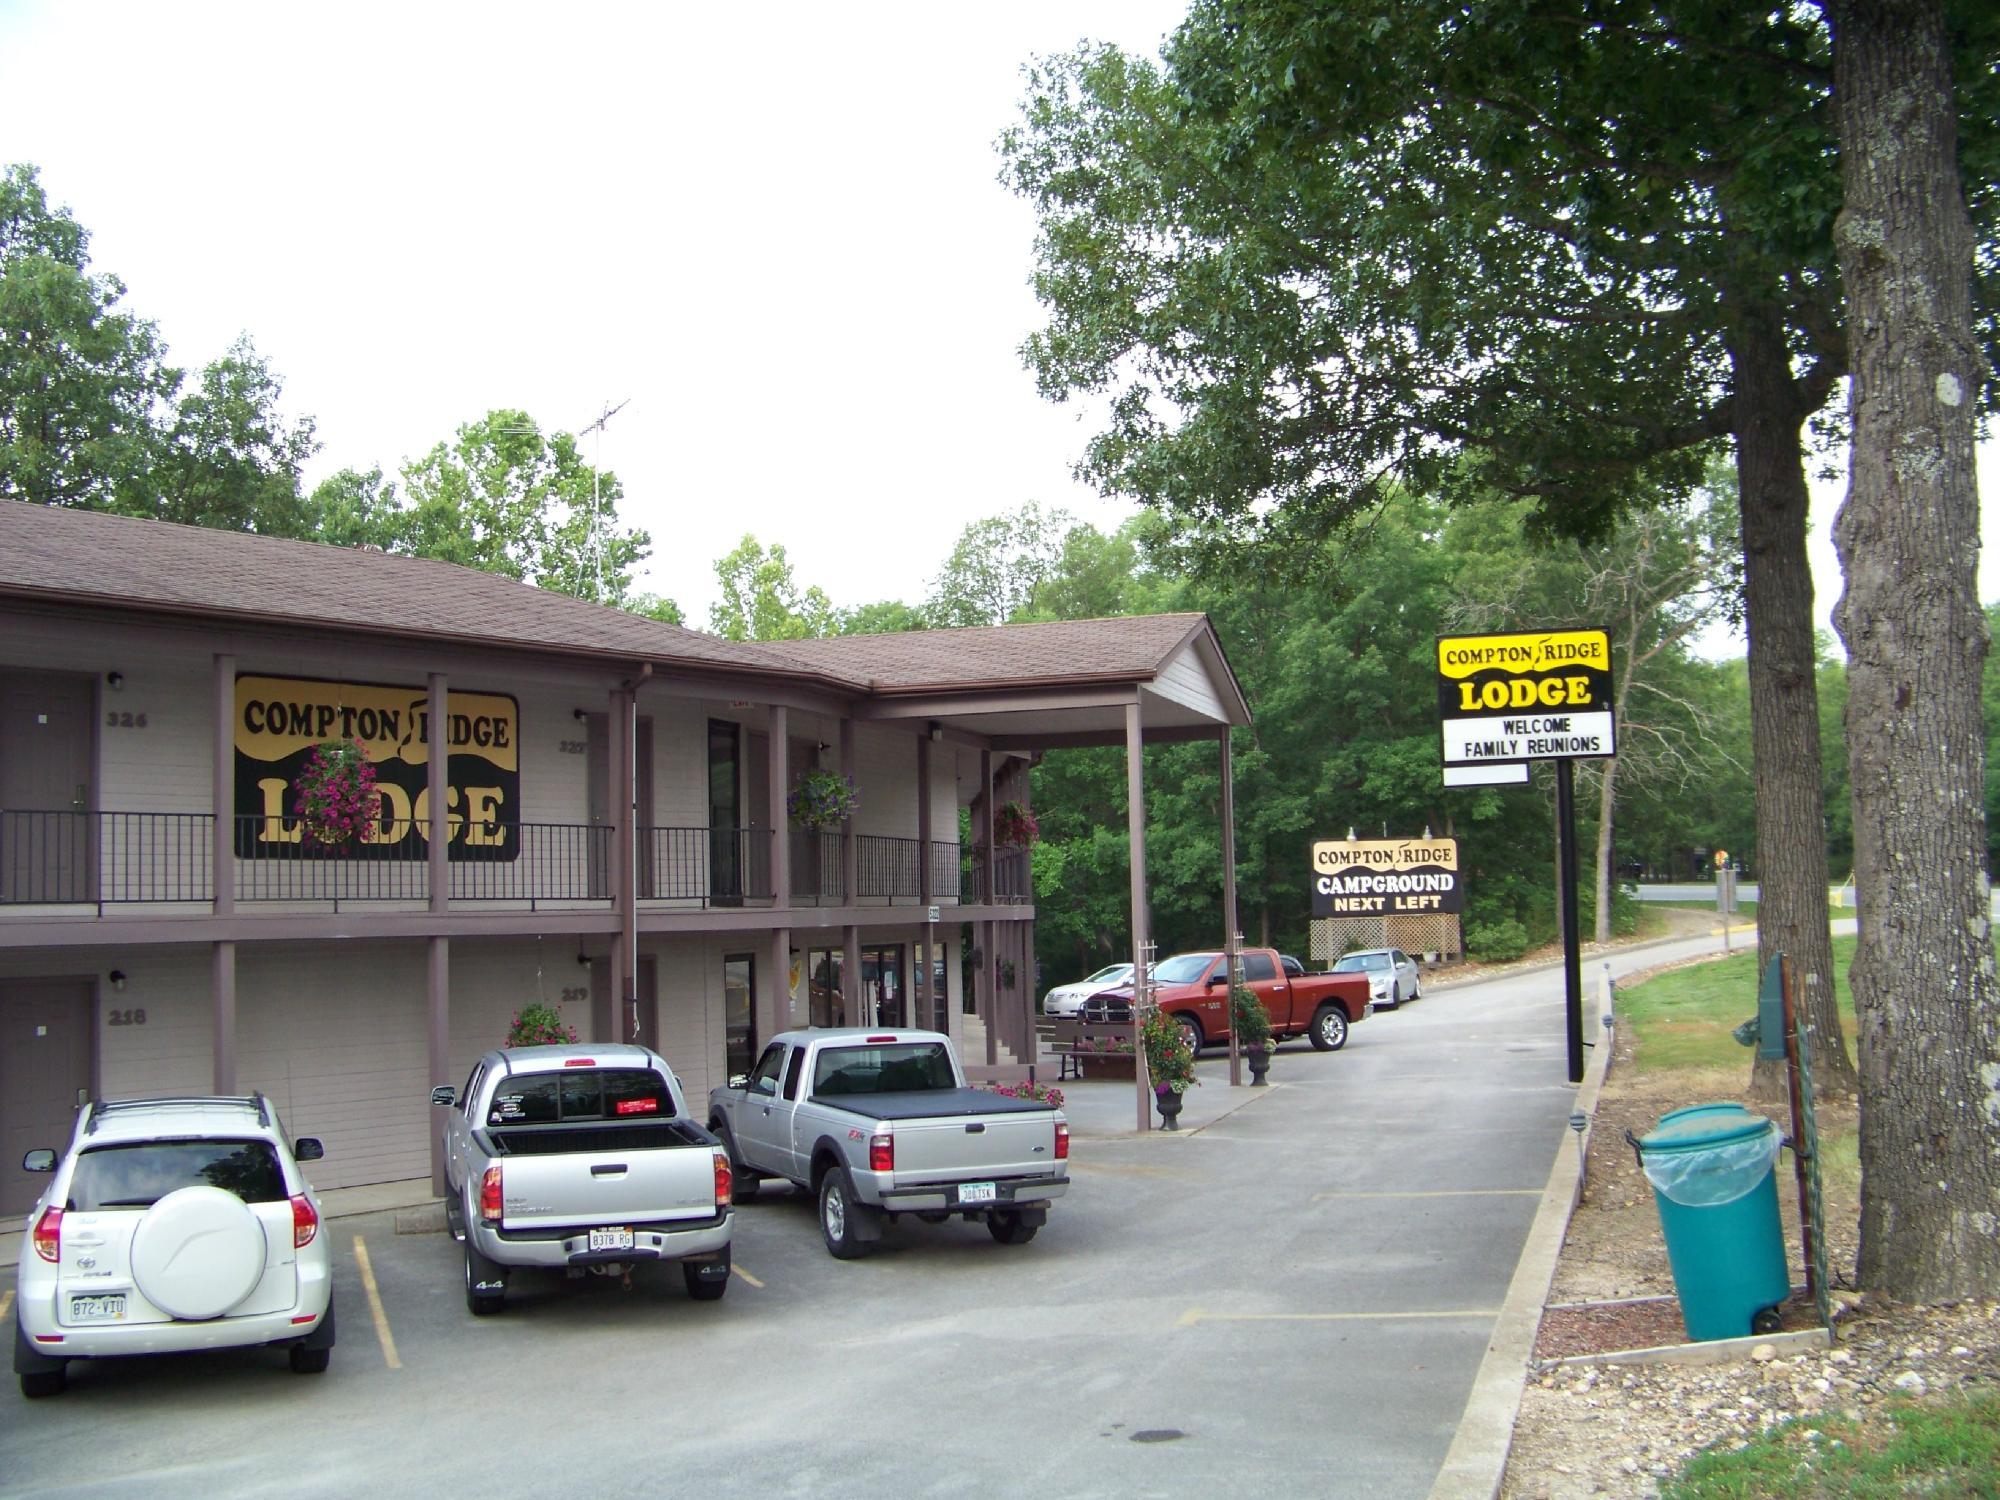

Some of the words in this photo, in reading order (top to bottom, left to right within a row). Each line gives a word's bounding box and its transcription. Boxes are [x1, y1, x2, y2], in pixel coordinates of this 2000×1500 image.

[1446, 645, 1533, 665] COMPTON
[1545, 642, 1601, 660] RIDGE
[1458, 675, 1592, 711] LODGE
[106, 711, 148, 729] 326
[244, 699, 400, 743] COMPTON
[1503, 717, 1571, 736] WELCOME
[1464, 739, 1519, 757] FAMILY
[1527, 736, 1601, 754] REUNIONS
[258, 777, 507, 847] LDGE
[1318, 849, 1394, 865] COMPTON
[1403, 848, 1452, 863] RIDGE
[1316, 873, 1454, 895] CAMPGROUND
[1334, 897, 1385, 912] NEXT
[1395, 895, 1442, 910] LEFT
[108, 1008, 148, 1026] 218
